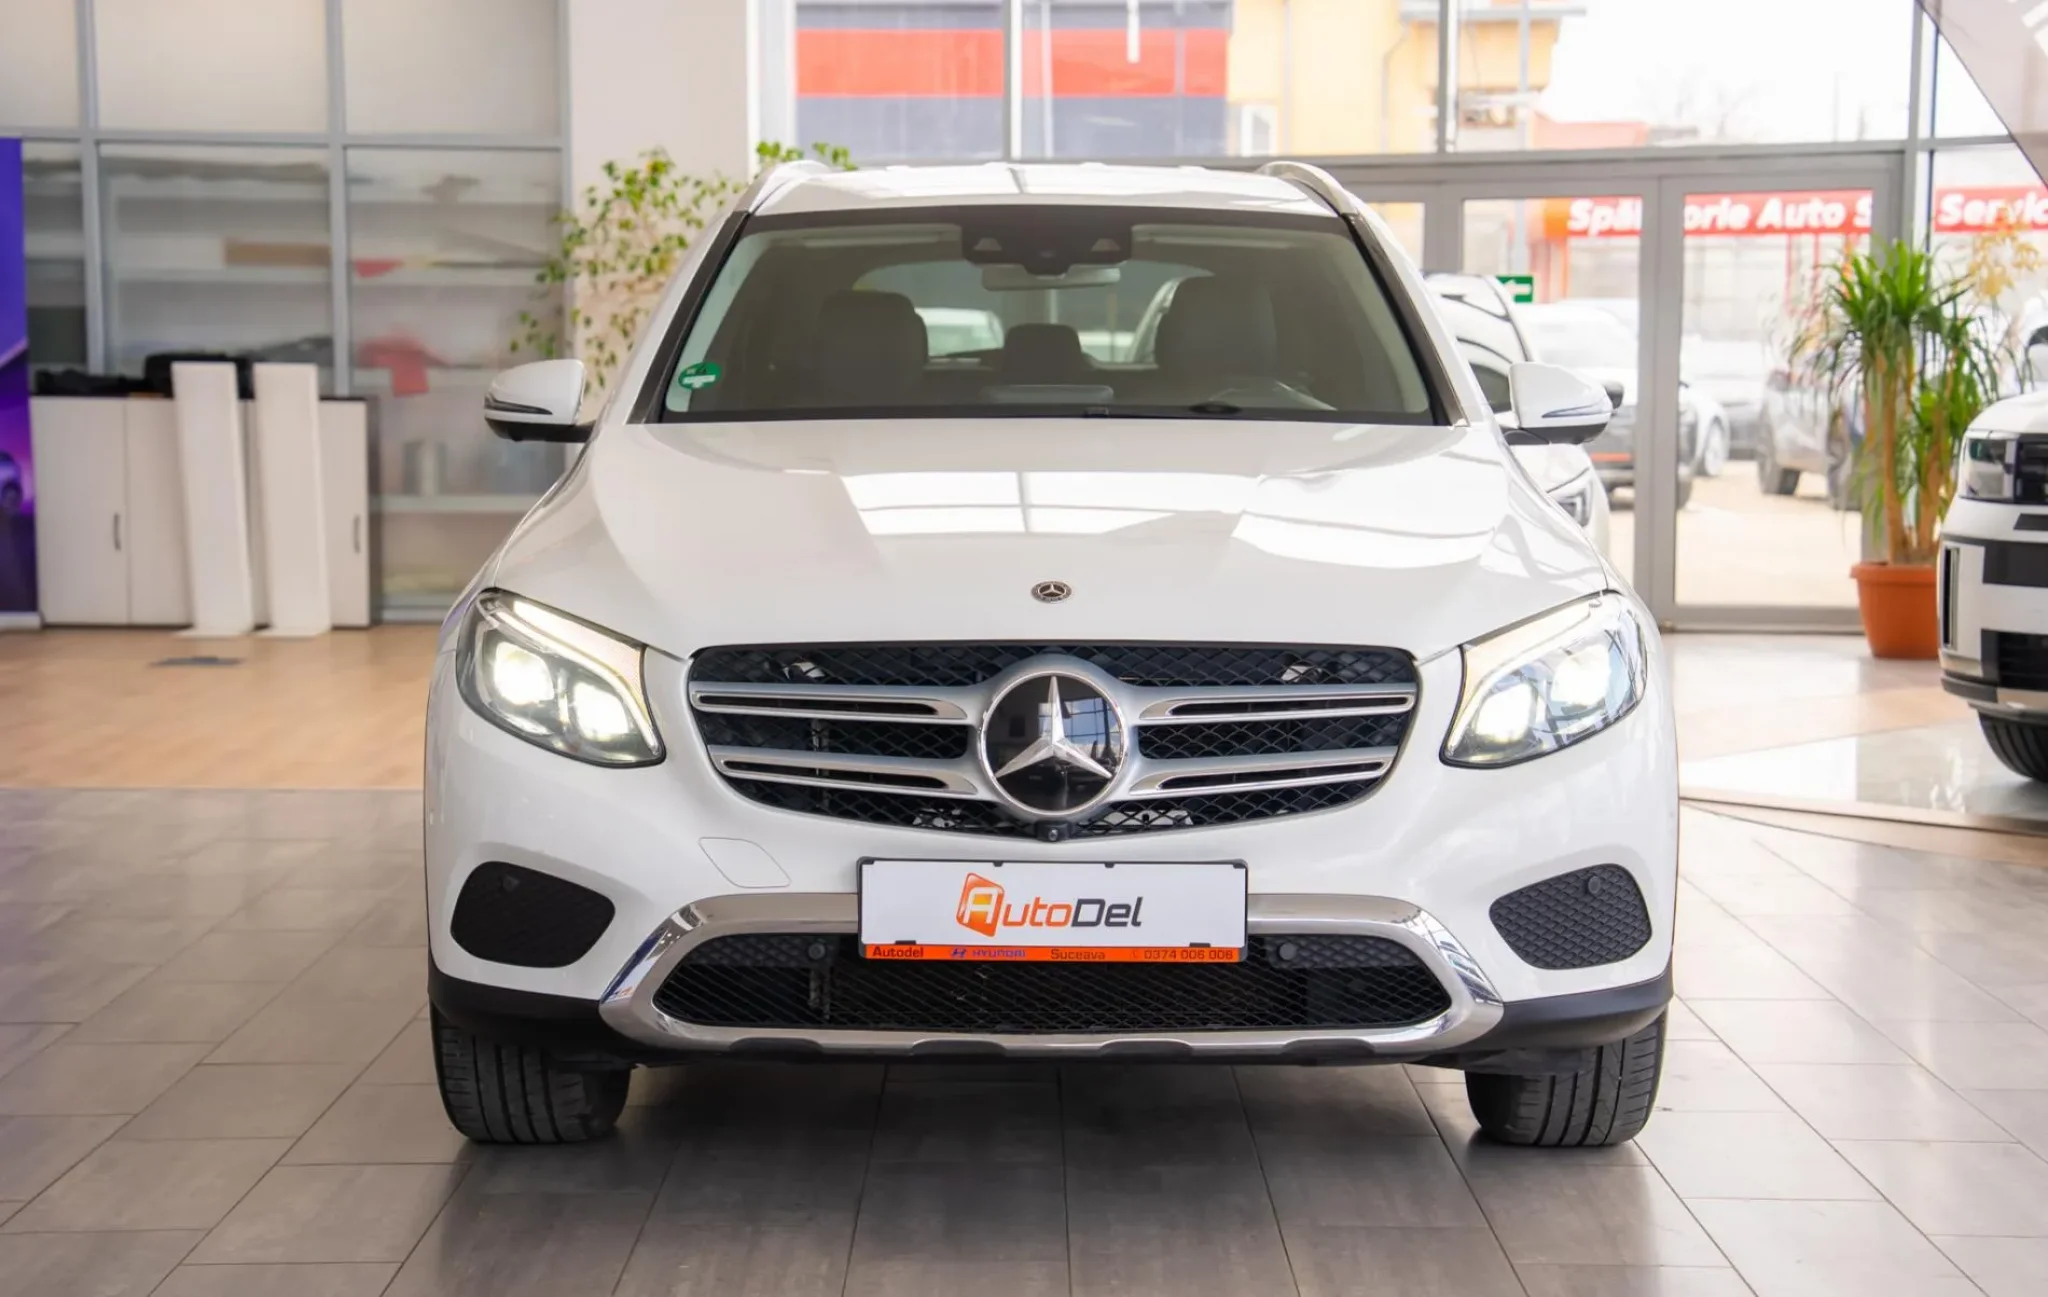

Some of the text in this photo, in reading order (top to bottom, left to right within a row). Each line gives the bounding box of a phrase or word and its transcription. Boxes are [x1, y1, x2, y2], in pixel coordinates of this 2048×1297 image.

[1755, 196, 1846, 229] Auto
[960, 883, 1144, 929] AutoDel
[872, 945, 924, 959] Autodel
[1050, 947, 1107, 961] Suceava
[1143, 948, 1177, 961] 0374
